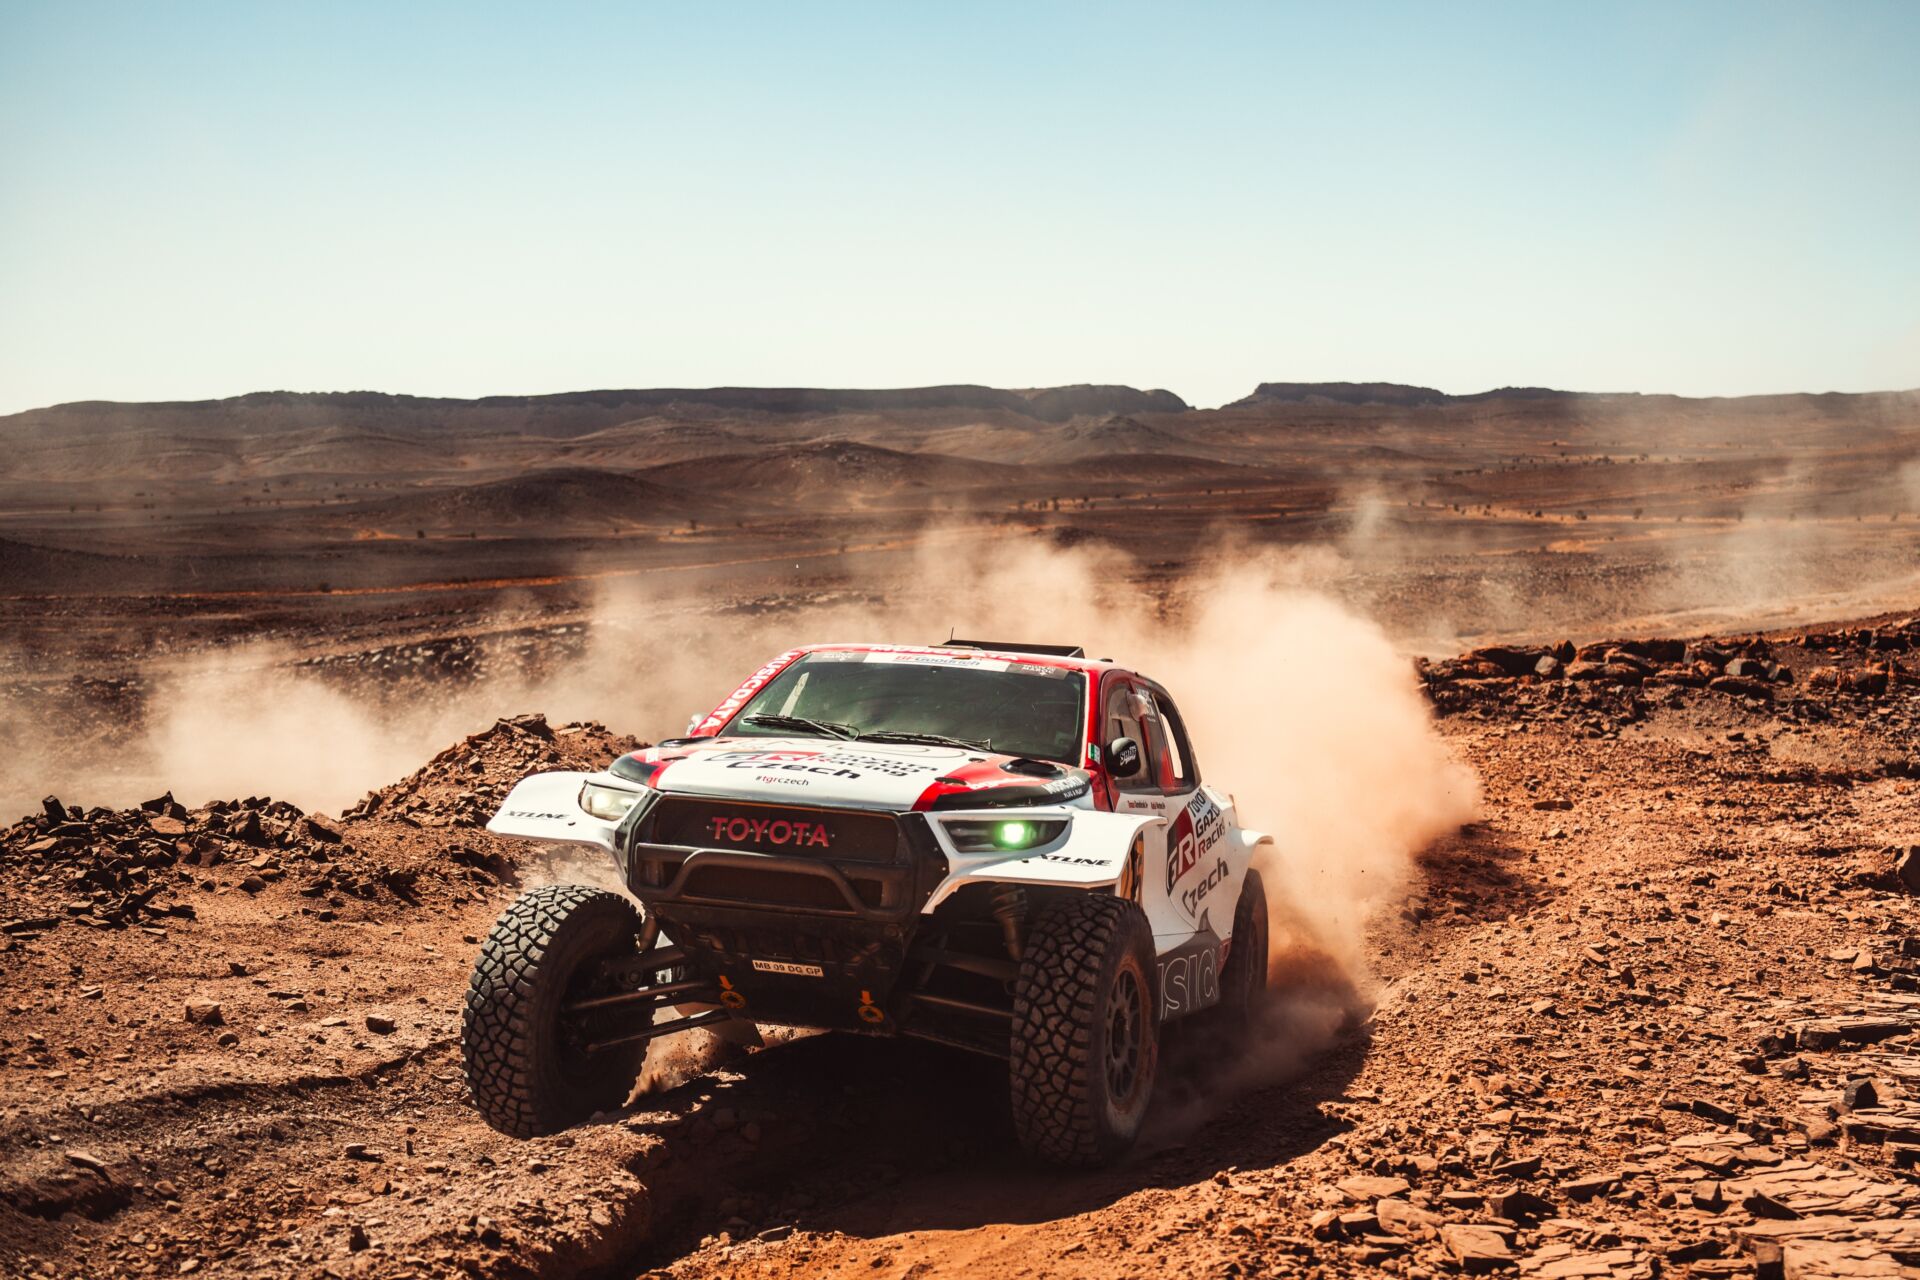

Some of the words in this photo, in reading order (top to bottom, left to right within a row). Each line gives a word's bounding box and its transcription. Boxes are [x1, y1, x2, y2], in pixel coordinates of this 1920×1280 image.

[701, 650, 799, 728] MUSICDATA
[726, 761, 861, 779] Czech
[755, 774, 809, 787] #tgrczech
[712, 816, 829, 847] TOYOTA
[1040, 853, 1112, 867] XTLINE
[1182, 857, 1229, 918] Czech
[755, 961, 771, 970] MB
[773, 964, 785, 972] 09
[806, 967, 821, 976] GP
